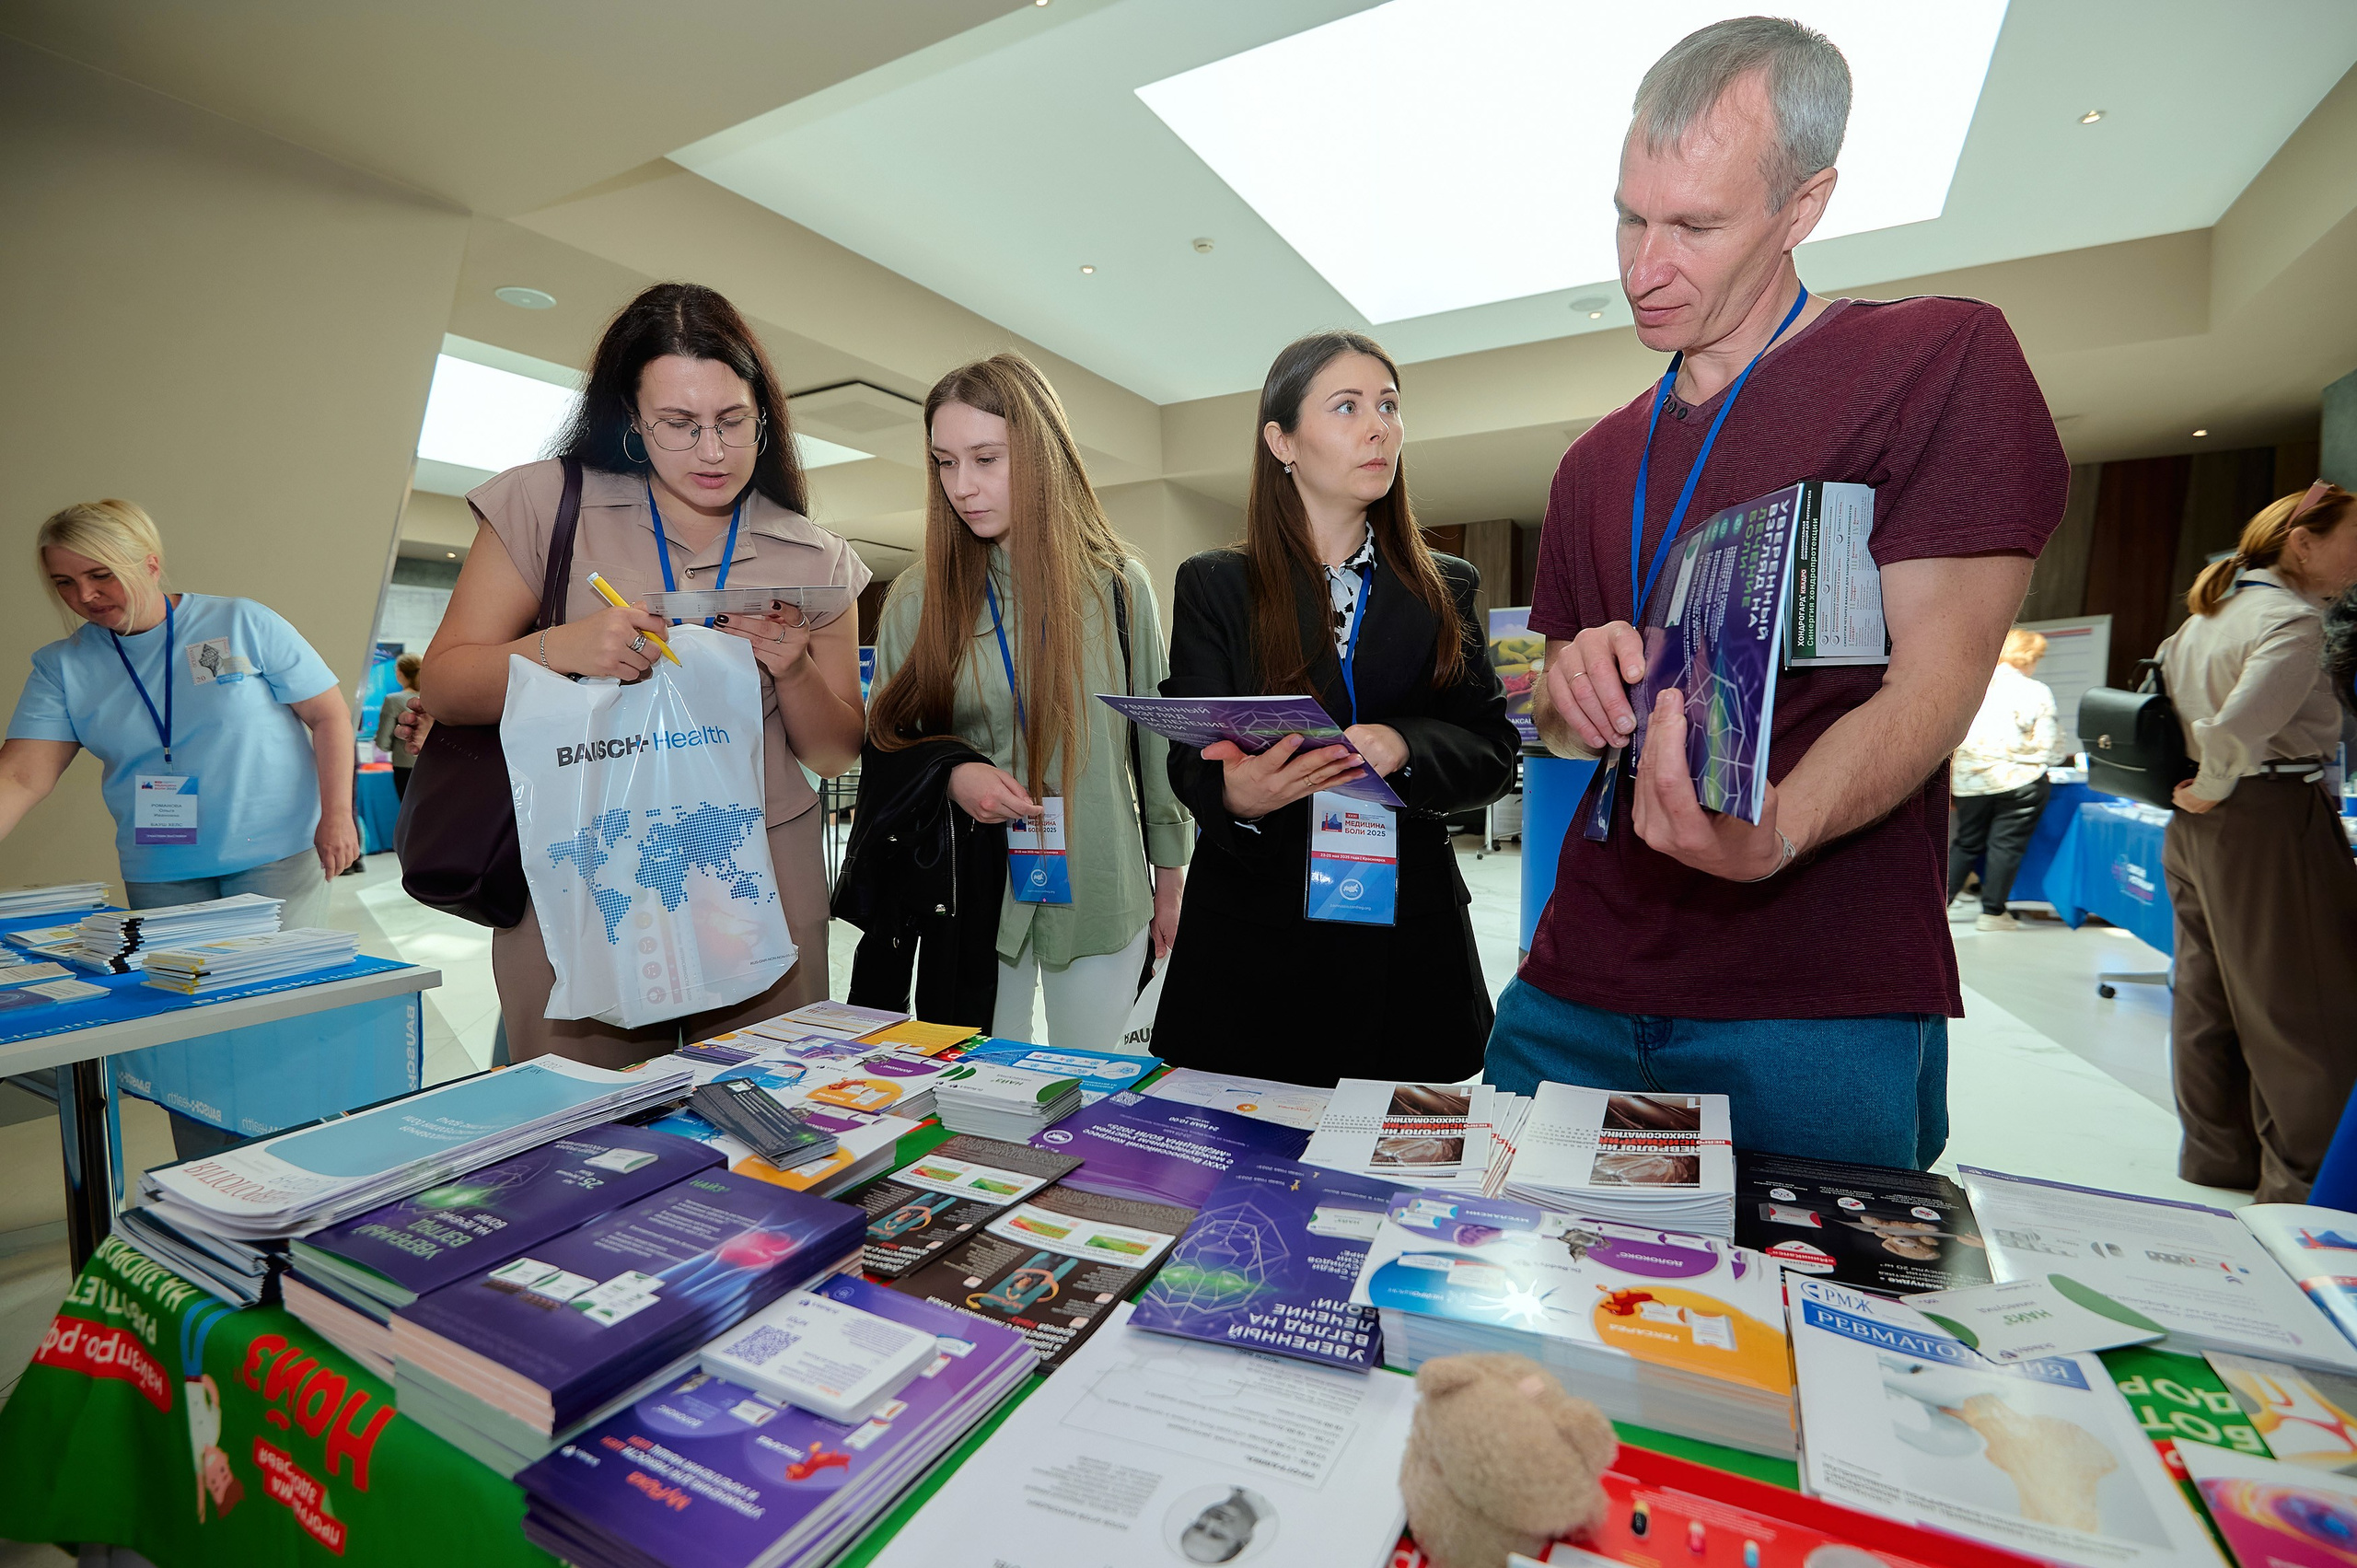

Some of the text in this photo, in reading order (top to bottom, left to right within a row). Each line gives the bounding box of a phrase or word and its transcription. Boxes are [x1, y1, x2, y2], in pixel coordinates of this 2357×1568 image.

[1852, 525, 1859, 534] IV
[1740, 506, 1767, 608] ЛЕЧЕНИЕ
[1747, 503, 1778, 628] ВЗГЛЯД НА
[1755, 499, 1790, 640] УВЕРЕННЫЙ
[1807, 517, 1818, 645] Синергия хондропротекции
[1119, 703, 1210, 714] УВЕРЕННЫЙ
[1129, 710, 1190, 720] ВЗГЛЯД
[1162, 719, 1229, 728] ЛЕЧЕНИЕ
[653, 726, 730, 750] Health
[1345, 820, 1386, 829] МЕДИЦИНА
[1686, 1097, 1700, 1108] 1
[1167, 1115, 1190, 1125] 10:00
[1189, 1120, 1207, 1130] МАЯ
[1091, 1123, 1225, 1162] международным участием
[1106, 1121, 1231, 1157] «МЕДИЦИНА БОЛИ 2025»
[1598, 1136, 1696, 1144] ПСИХИАТРИЯ
[1599, 1130, 1700, 1138] ПСИХОСОМАТИКА
[1081, 1126, 1228, 1171] XXXI Всероссийский конгресс
[1597, 1143, 1699, 1152] НЕВРОЛОГИЯ
[576, 1177, 604, 1189] 25
[432, 1209, 493, 1236] НА ЛЕЧЕНИЕ
[1464, 1208, 1529, 1224] МУСЛАКСИН
[348, 1221, 444, 1260] УВЕРЕННЫЙ
[408, 1214, 471, 1247] ВЗГЛЯД
[877, 1247, 920, 1260] совместно
[898, 1244, 929, 1255] бренда
[1311, 1263, 1347, 1273] СРЕДИ
[156, 1276, 198, 1312] НА
[924, 1295, 956, 1309] гелей
[1822, 1286, 1870, 1314] РМЖ
[1247, 1311, 1369, 1346] ВЗГЛЯД НА
[1271, 1301, 1374, 1331] ЛЕЧЕНИЕ
[1011, 1324, 1069, 1343] совместно
[1036, 1322, 1076, 1336] бренда
[1225, 1321, 1365, 1362] УВЕРЕННЫЙ
[1608, 1322, 1678, 1342] ТЕКСАРЕД
[37, 1318, 162, 1396] найзпро.рф
[2116, 1374, 2241, 1414] ДОР
[2139, 1404, 2263, 1450] БОТ
[619, 1445, 673, 1477] ГИБКОСТИ
[681, 1458, 749, 1496] УКРЕПЛЕНИЯ
[688, 1478, 765, 1519] УПРАЖНЕНИЯ
